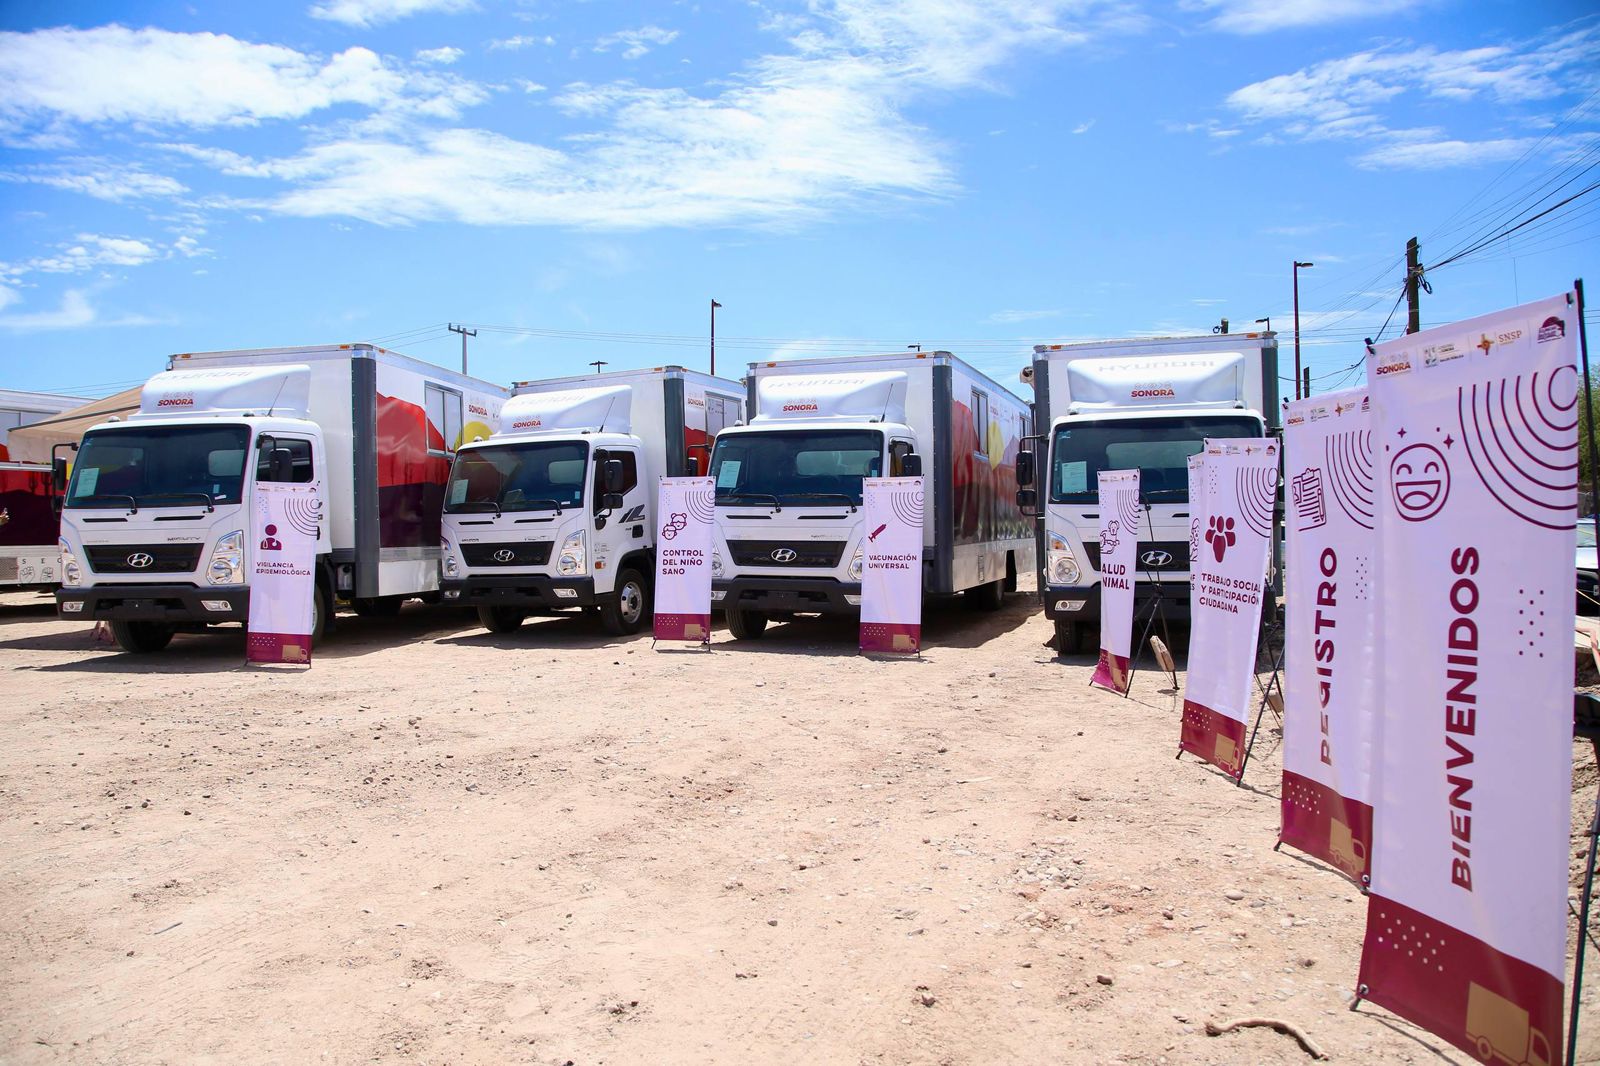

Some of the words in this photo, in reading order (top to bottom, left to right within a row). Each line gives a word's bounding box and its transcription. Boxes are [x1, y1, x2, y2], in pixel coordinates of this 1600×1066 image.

[1498, 330, 1522, 342] SNSP
[1099, 360, 1217, 372] HYUNDAI
[1376, 361, 1411, 375] SONORA
[1131, 389, 1175, 398] SONORA
[157, 398, 194, 407] SONORA
[782, 404, 818, 412] SONORA
[468, 404, 488, 417] SONORA
[512, 420, 541, 429] SONORA
[662, 549, 704, 557] CONTROL
[868, 553, 917, 561] VACUNACIÓN
[680, 557, 703, 566] NIÑO
[256, 568, 311, 576] EPIDEMIOLÓGICA
[1101, 563, 1126, 576] ALUD
[1102, 578, 1130, 590] NIMAL
[1201, 573, 1231, 587] TRABAJO
[1233, 579, 1261, 592] SOCIAL
[1201, 585, 1207, 593] Y
[1208, 586, 1260, 605] PARTICIPACIÓN
[1199, 597, 1239, 614] CIUDADANA
[1445, 546, 1480, 893] BIENVENIDOS
